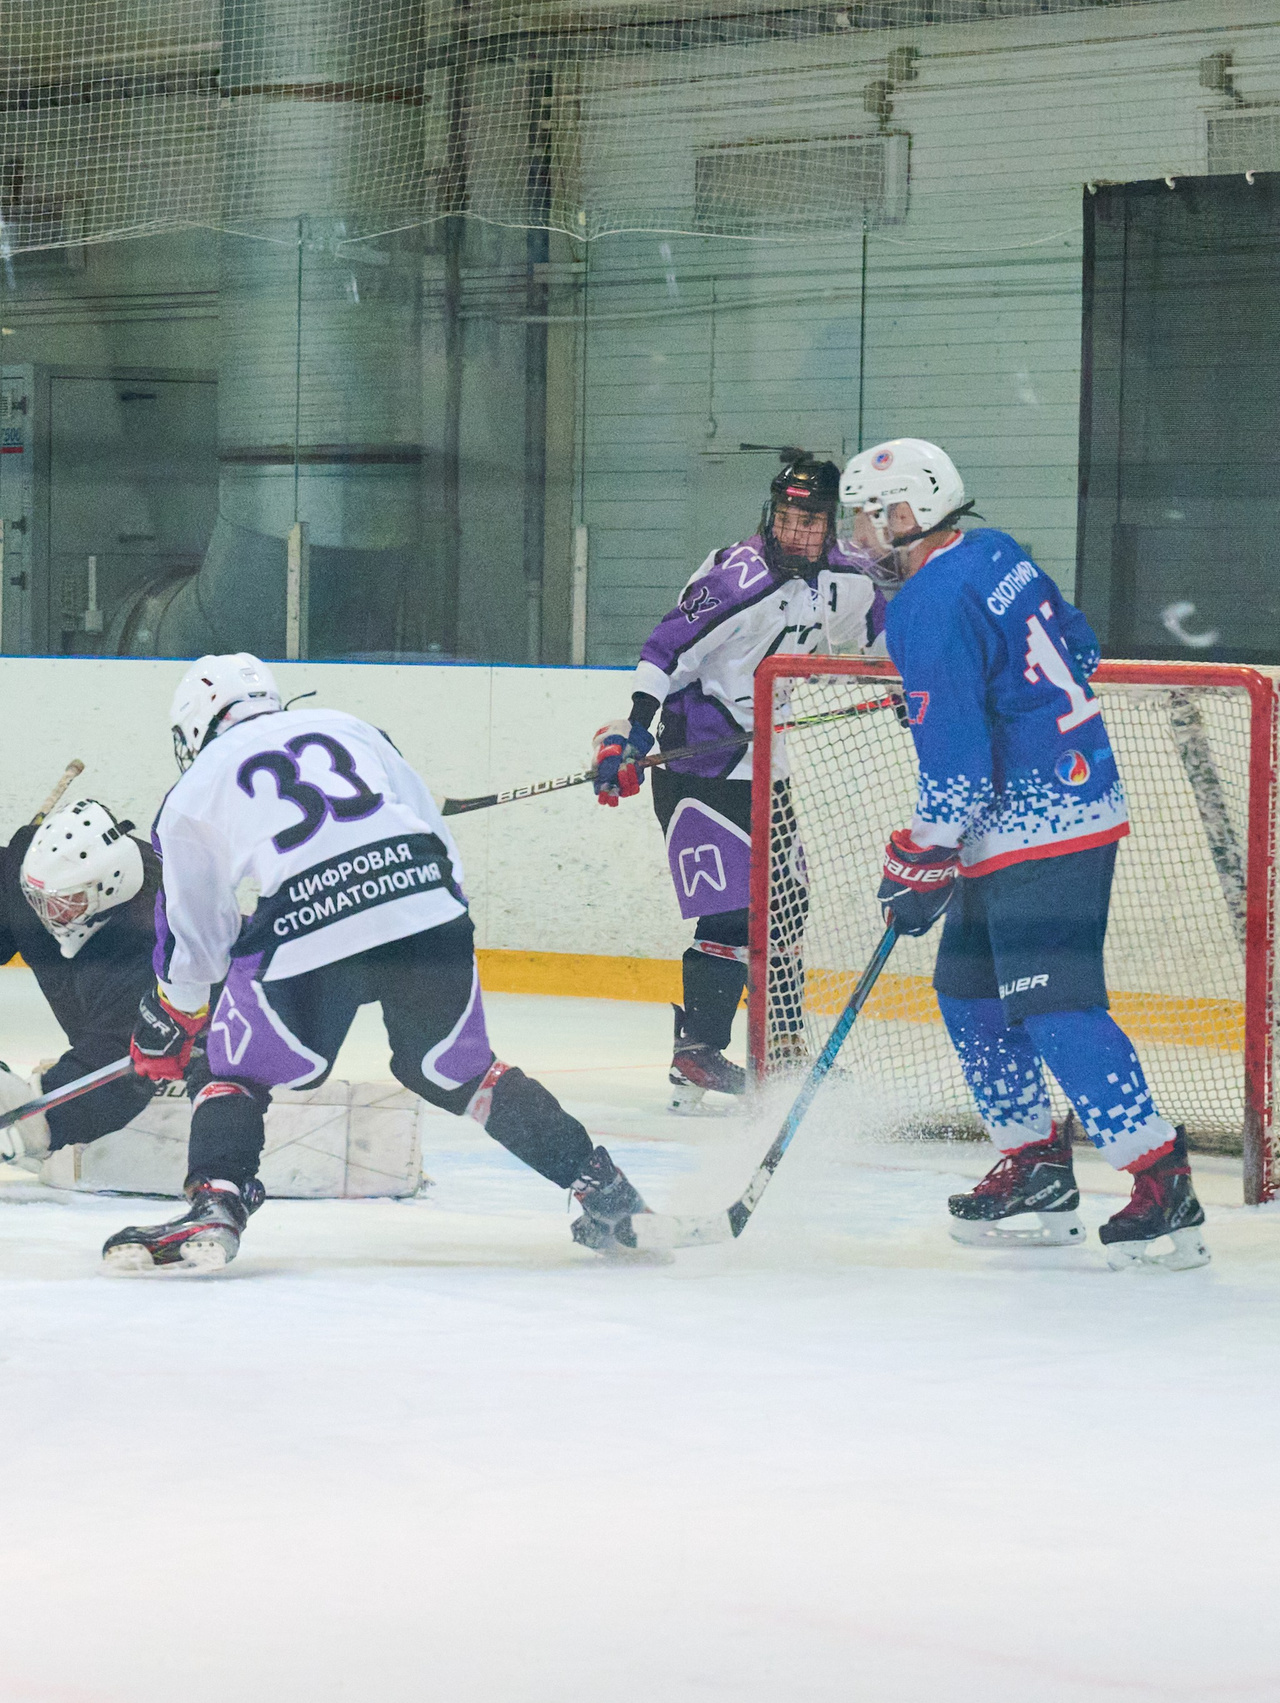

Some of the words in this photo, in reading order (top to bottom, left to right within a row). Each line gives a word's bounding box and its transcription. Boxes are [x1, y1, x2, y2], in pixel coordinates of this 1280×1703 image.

[881, 486, 908, 496] CCM
[236, 732, 385, 854] 33
[497, 771, 588, 804] BAUER
[273, 862, 442, 936] СТОМАТОЛОГИЯ
[289, 842, 414, 904] ЦИФРОВАЯ
